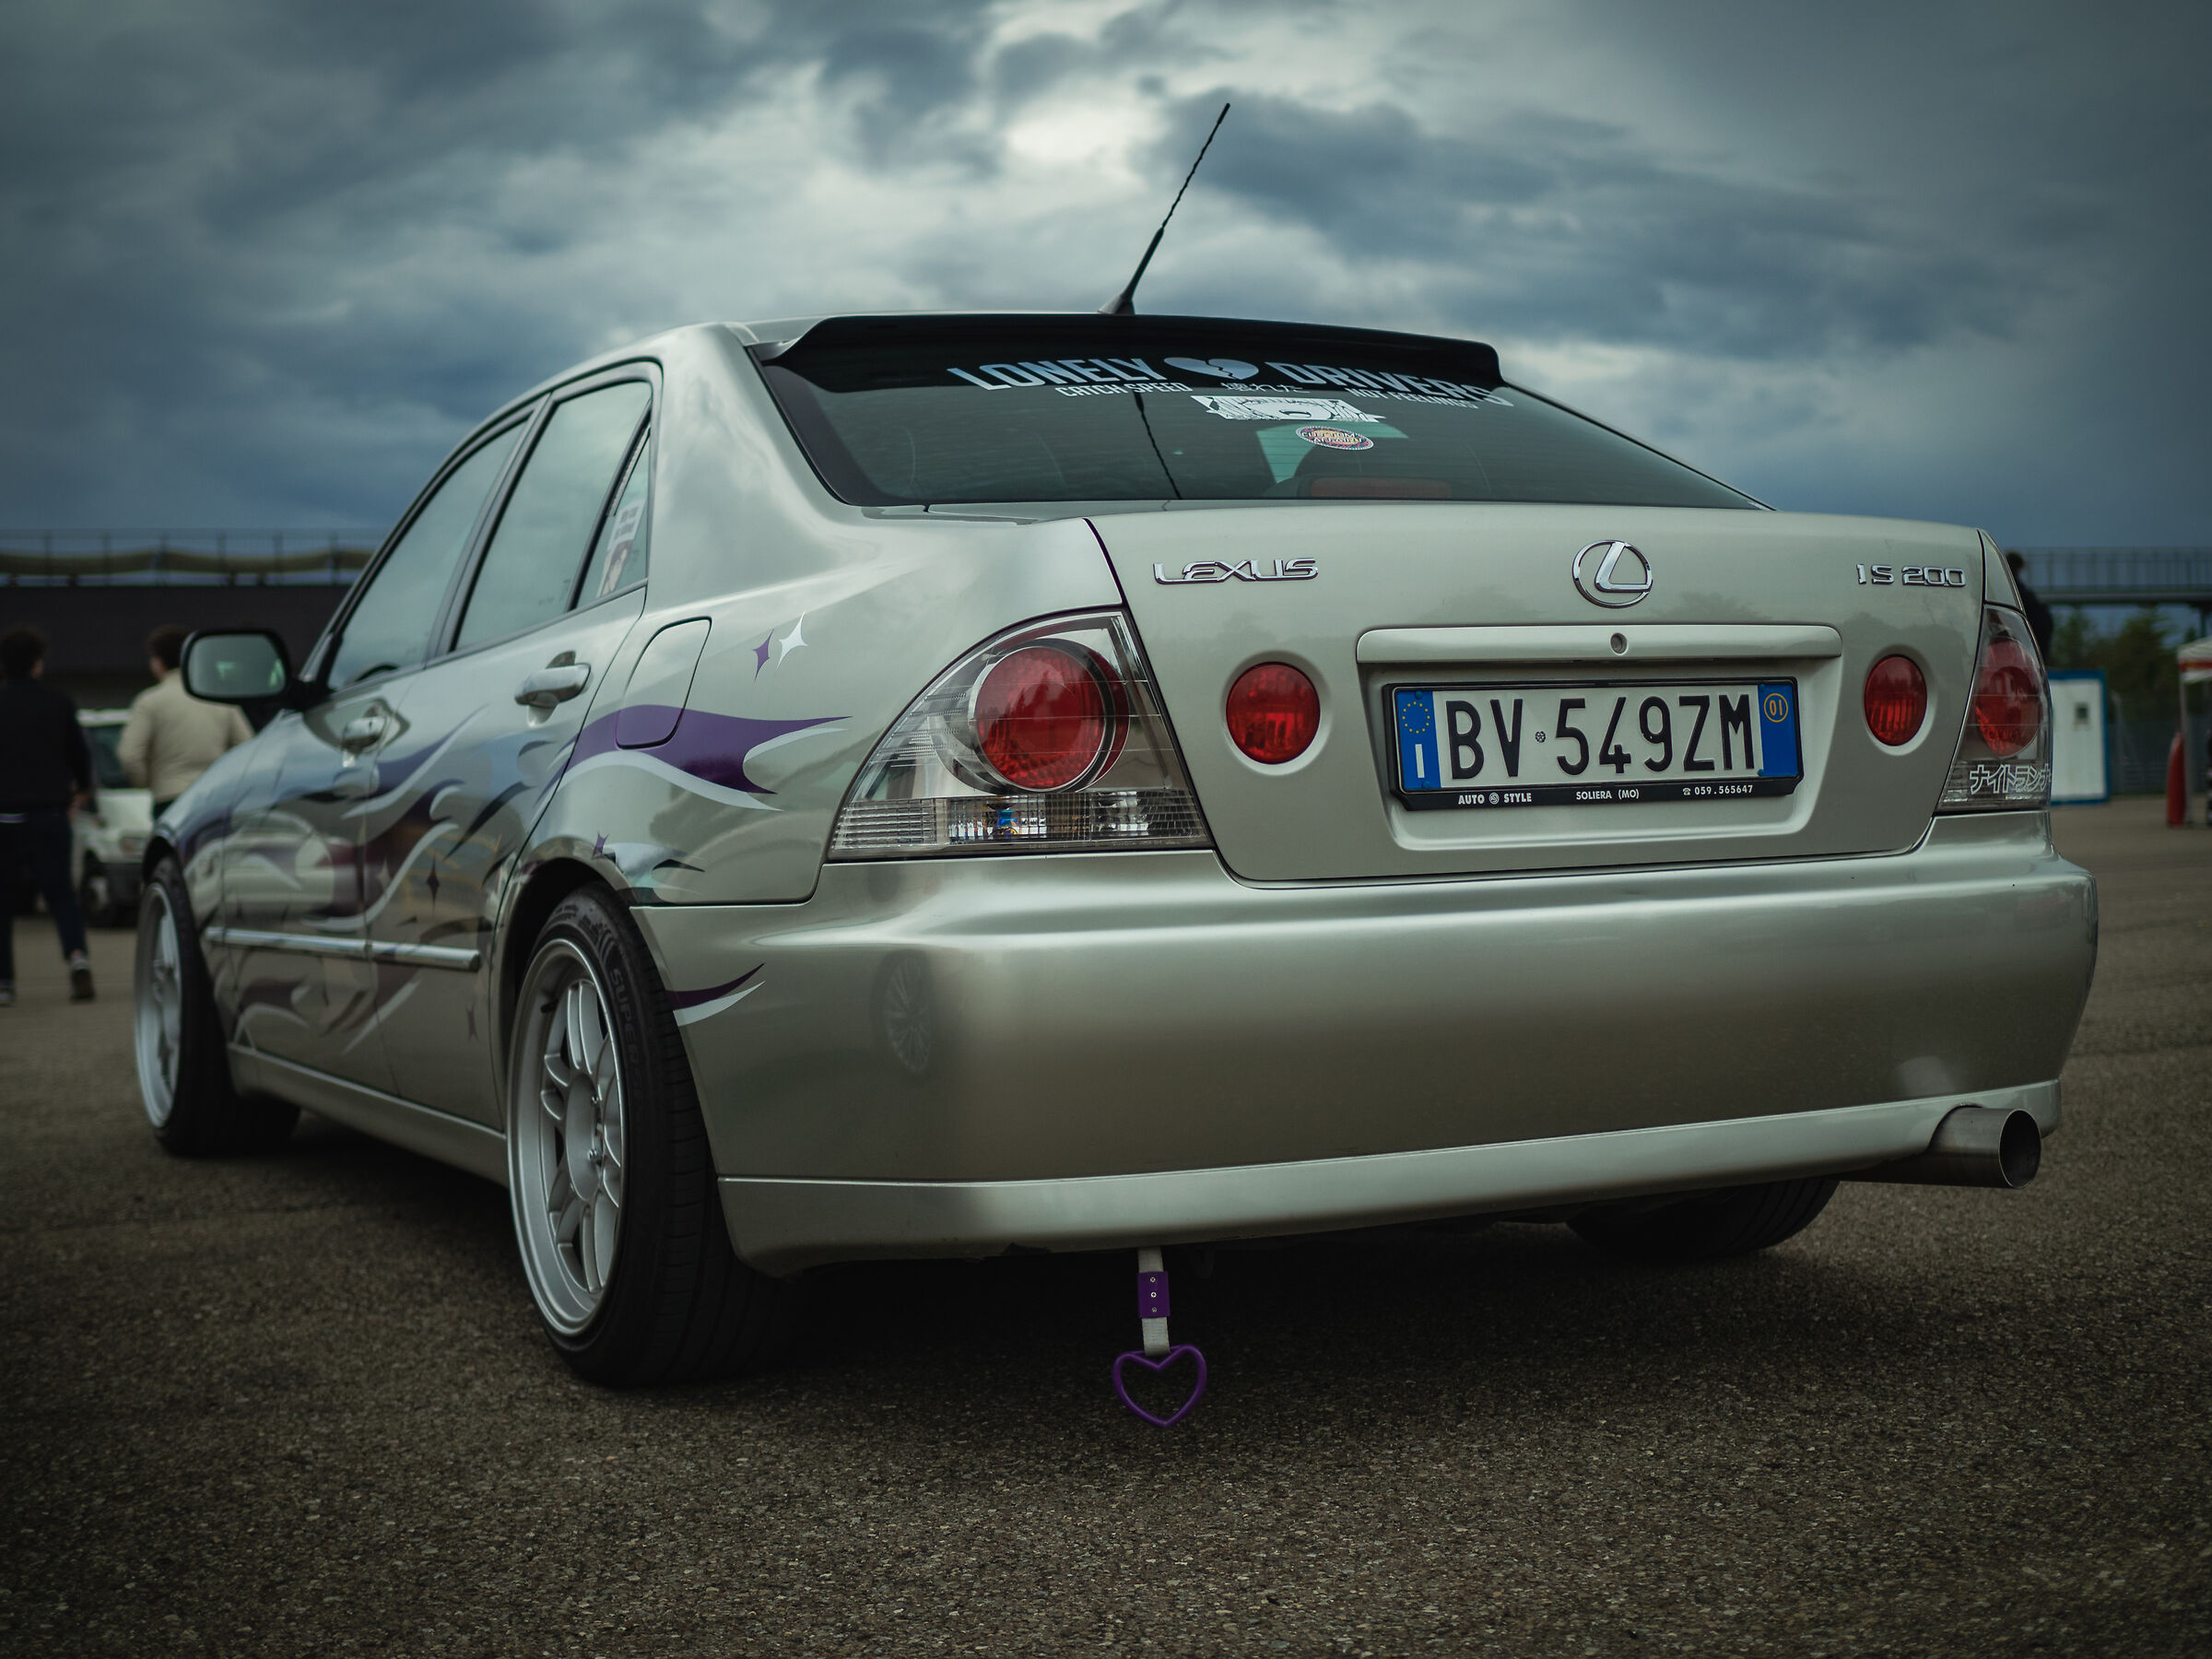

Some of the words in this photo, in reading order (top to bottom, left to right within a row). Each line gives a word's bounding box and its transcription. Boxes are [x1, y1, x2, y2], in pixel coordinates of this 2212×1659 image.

[947, 358, 1167, 390] LONELY
[1265, 361, 1513, 406] DRIVERS
[1054, 384, 1128, 397] CATCH
[1124, 382, 1194, 393] SPEED
[1346, 388, 1389, 399] NOT
[1152, 557, 1319, 584] LEXUS
[1856, 563, 1895, 584] IS
[1901, 566, 1966, 588] 200
[1445, 698, 1524, 780] BV
[1555, 693, 1755, 775] 549ZM
[1458, 794, 1485, 805] AUTO
[1503, 793, 1532, 803] STYLE
[1575, 790, 1612, 800] SOLIERA
[1618, 788, 1640, 800] (MO)
